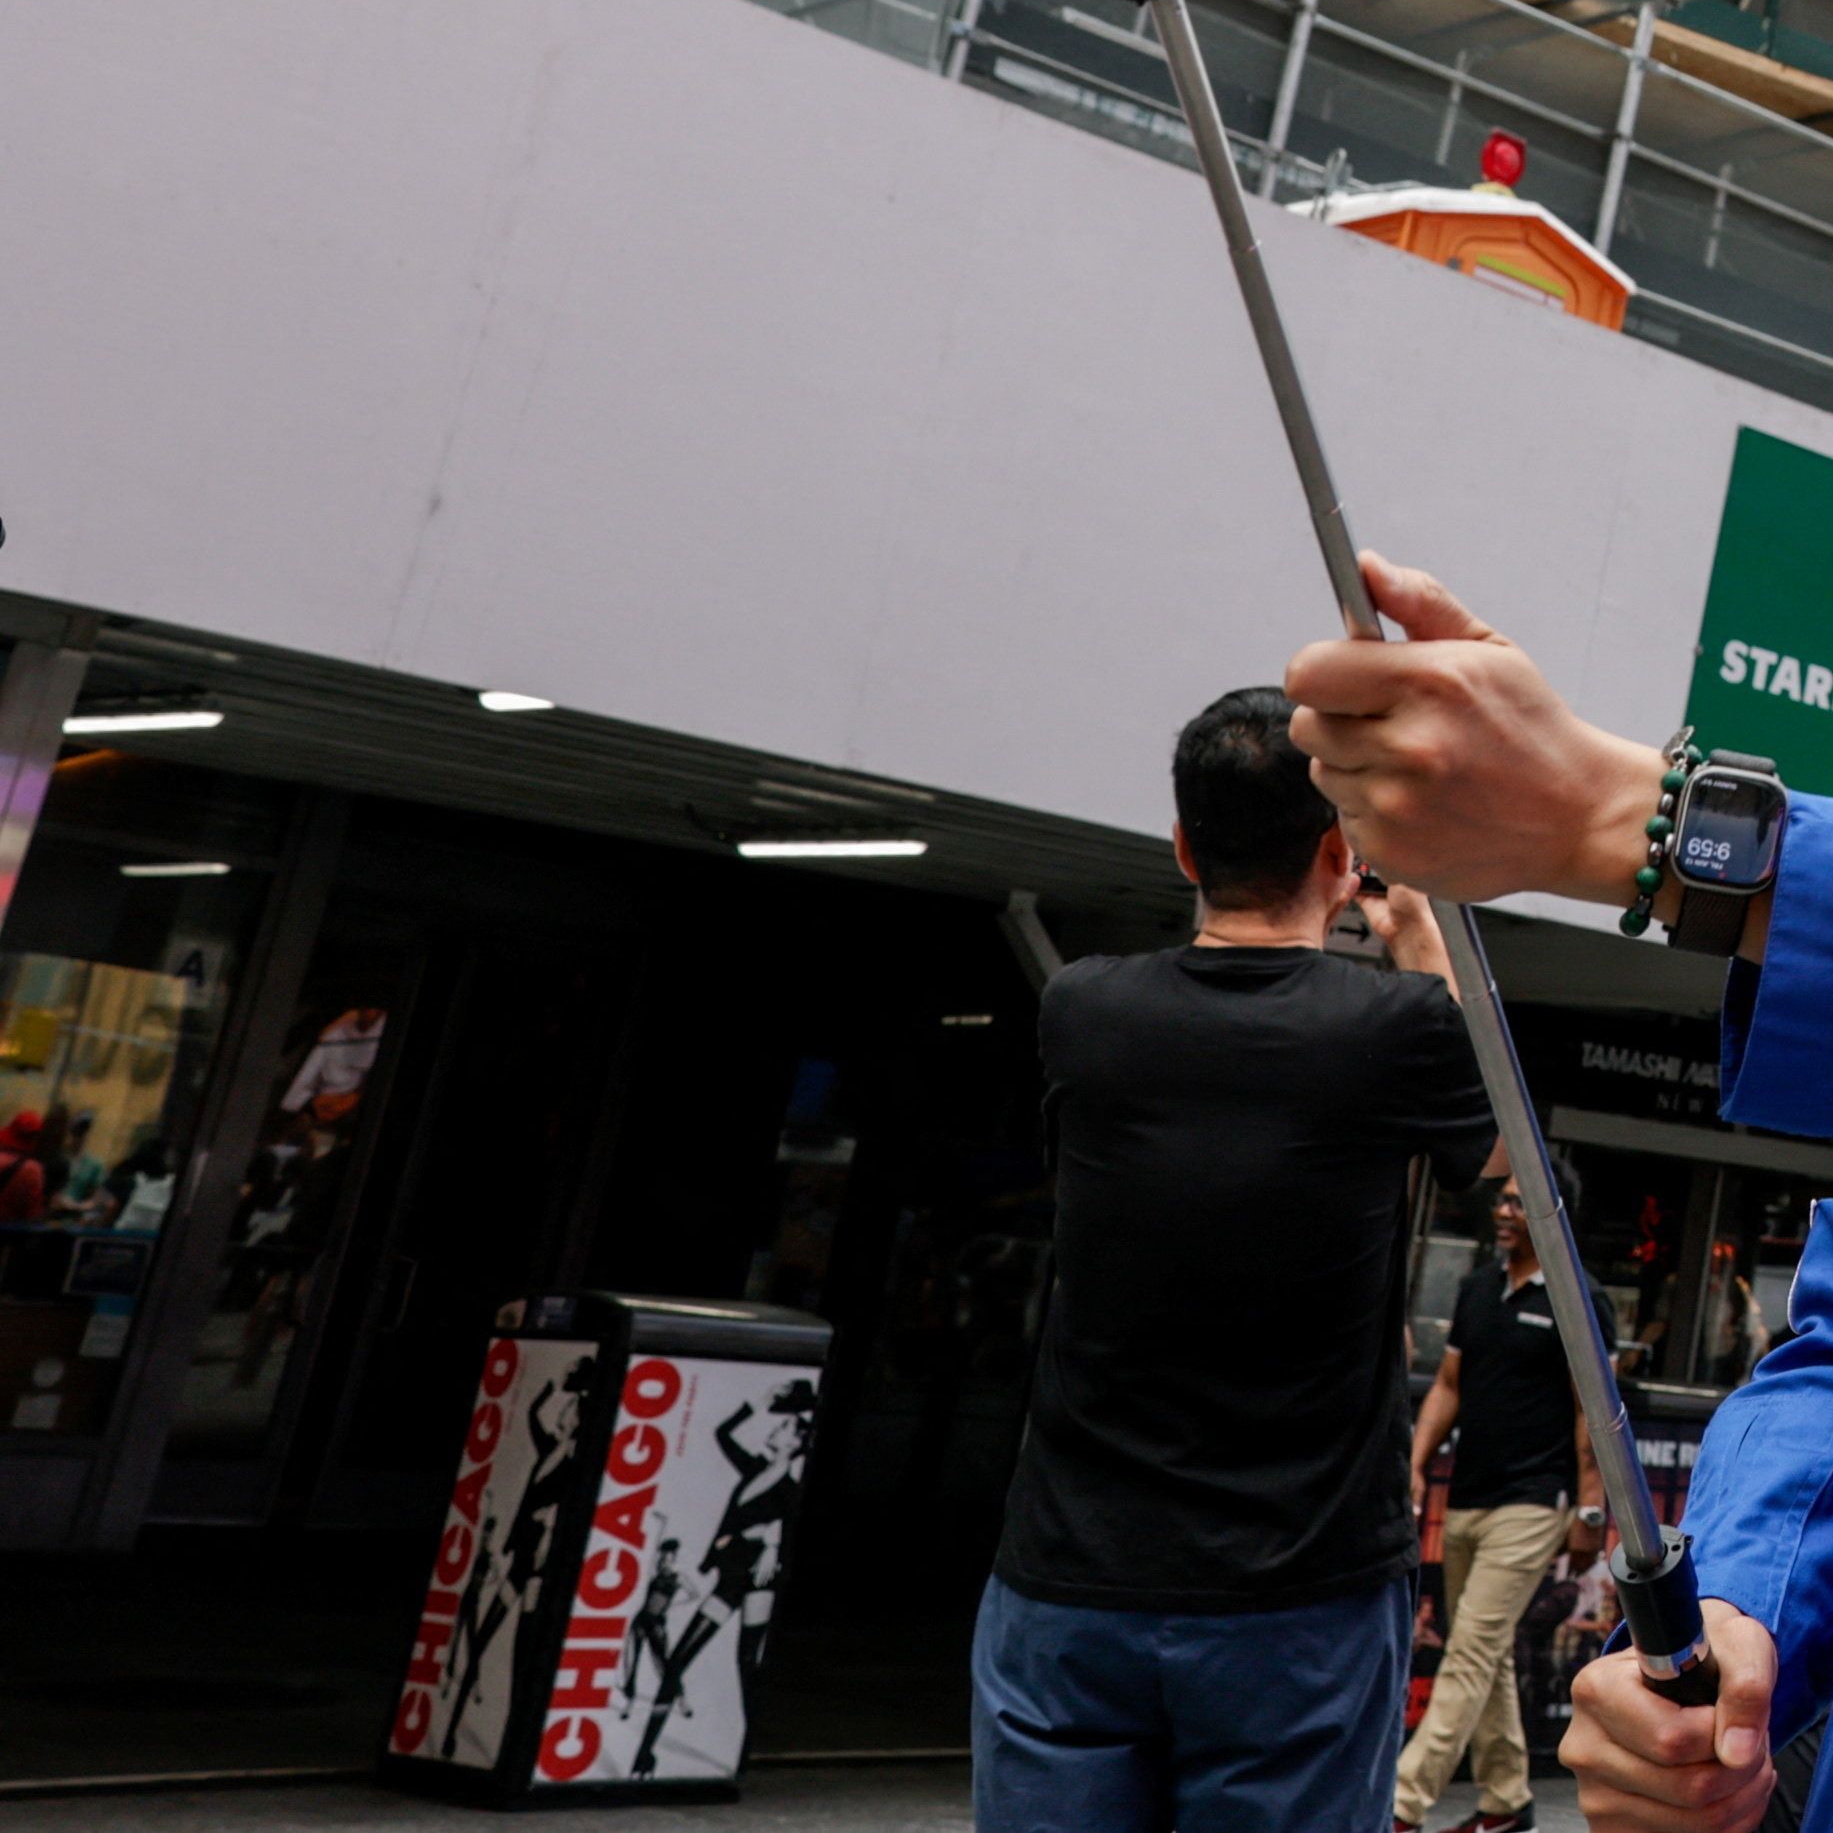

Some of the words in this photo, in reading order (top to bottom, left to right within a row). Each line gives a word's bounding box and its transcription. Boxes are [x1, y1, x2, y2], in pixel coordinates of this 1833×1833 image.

[1687, 837, 1731, 862] 9:59
[390, 1337, 519, 1755] CHICAGO
[538, 1356, 683, 1783] CHICAGO
